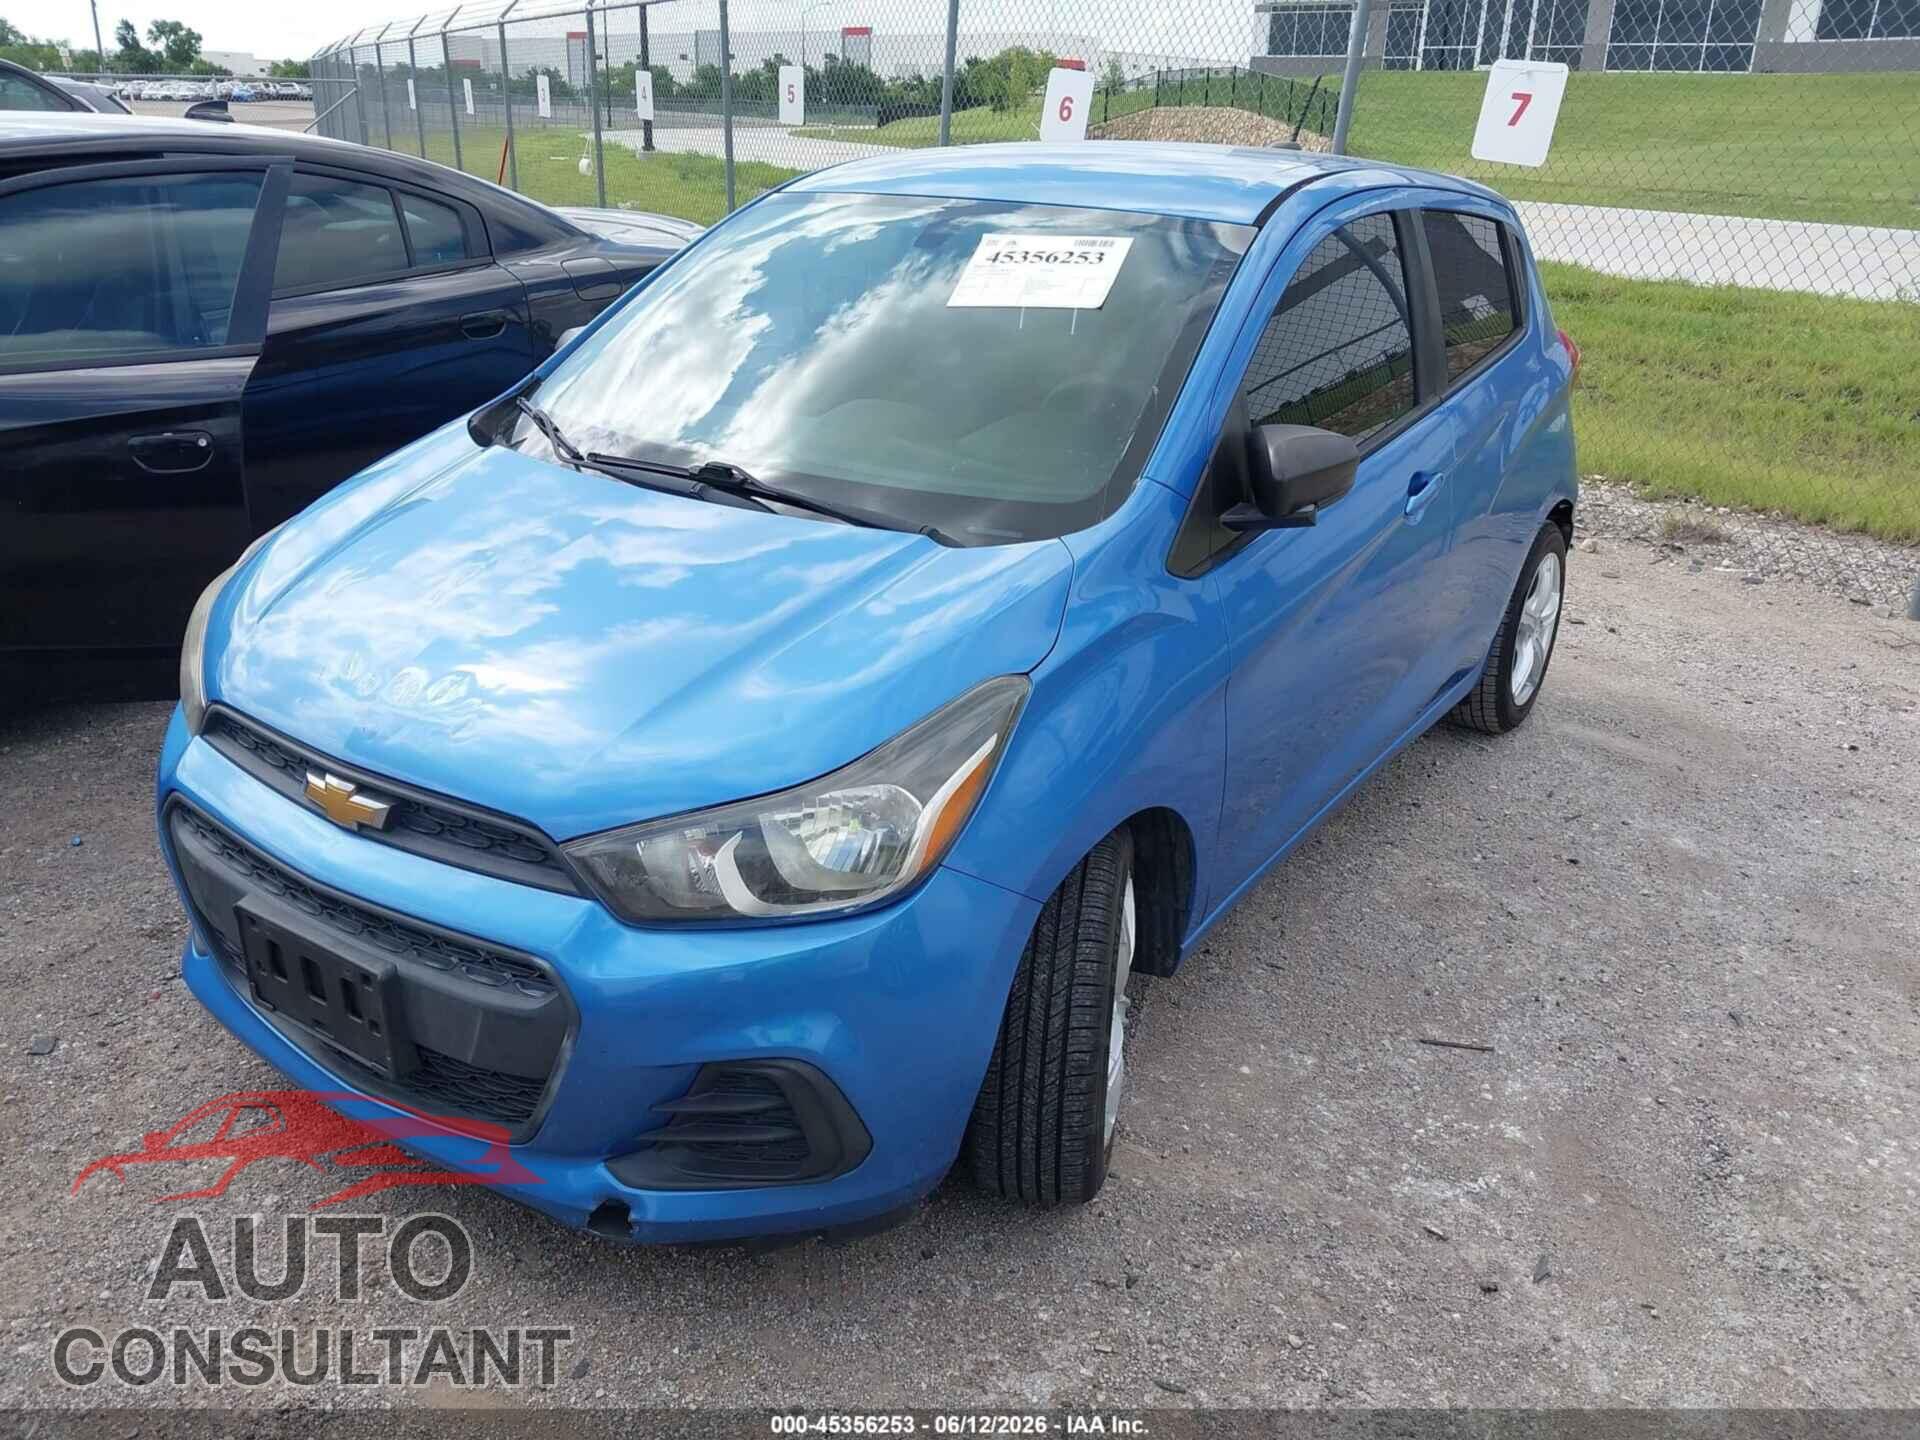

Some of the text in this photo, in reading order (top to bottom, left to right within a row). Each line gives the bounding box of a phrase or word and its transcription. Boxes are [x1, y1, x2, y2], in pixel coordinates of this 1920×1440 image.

[787, 84, 796, 104] 5
[1059, 96, 1074, 122] 6
[1508, 92, 1533, 126] 7
[985, 250, 1106, 265] 45356253
